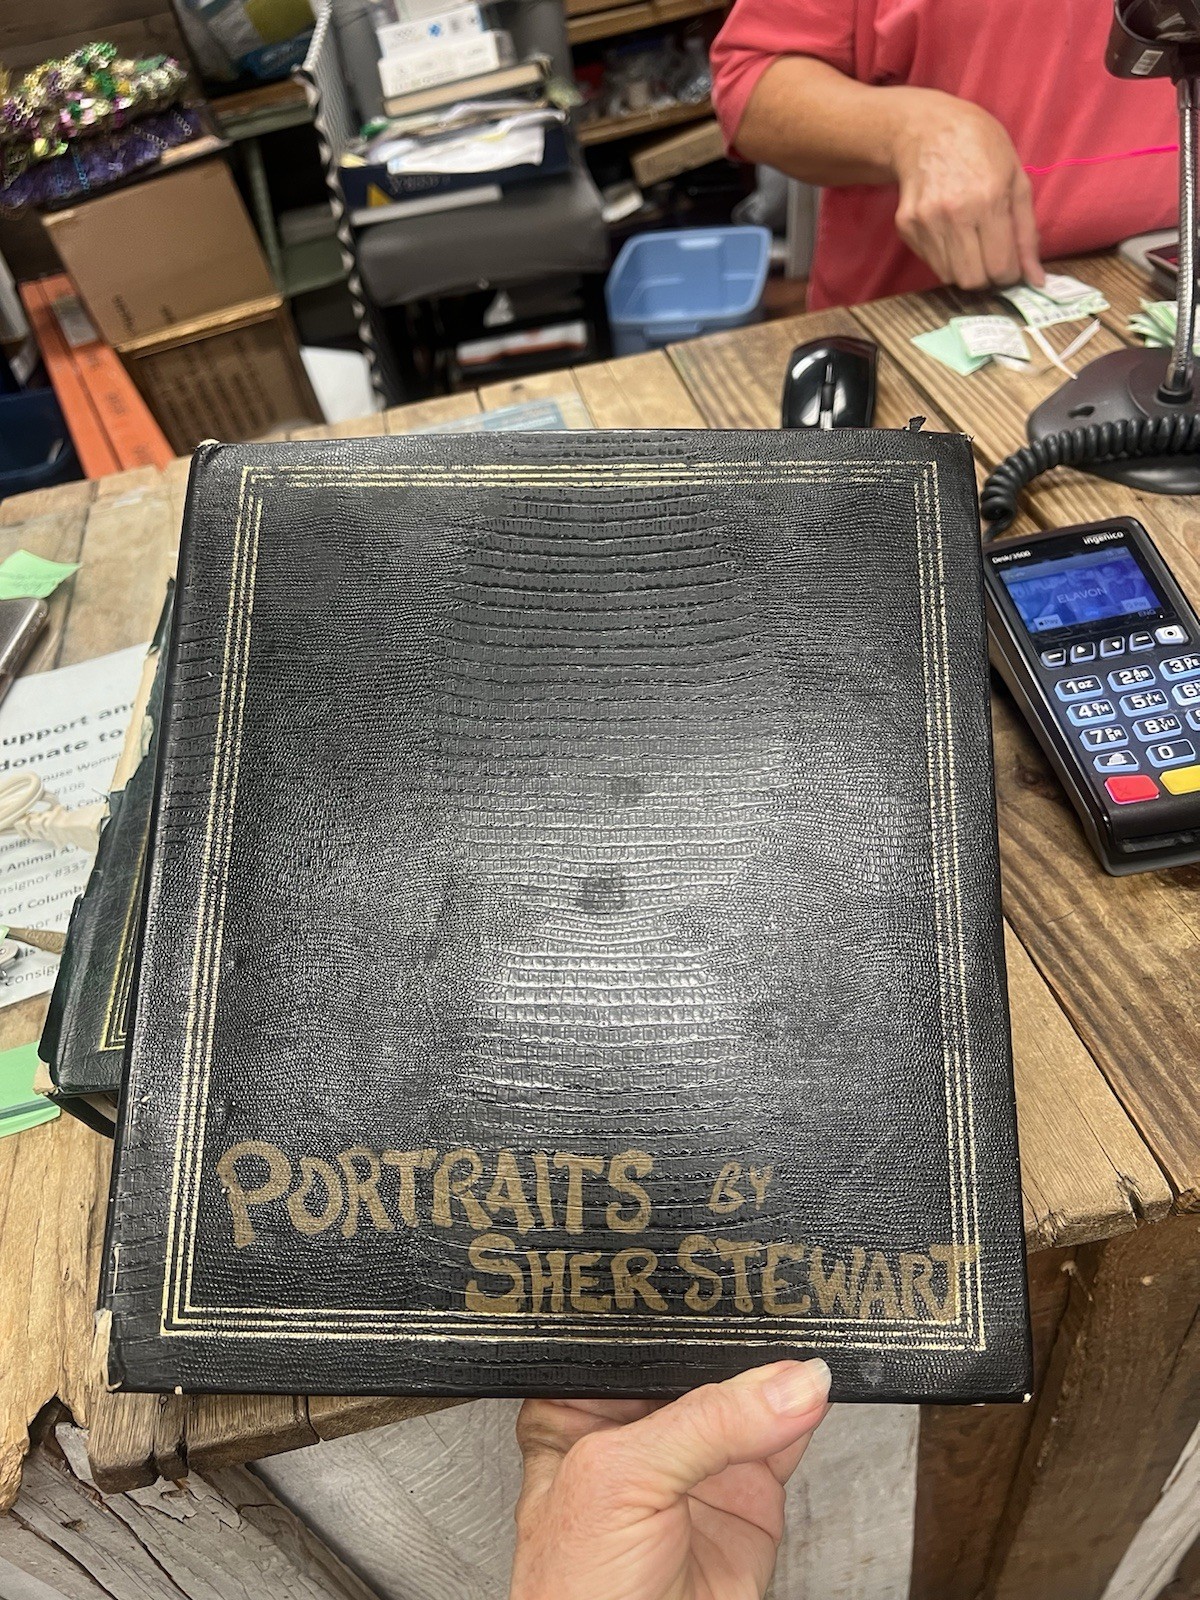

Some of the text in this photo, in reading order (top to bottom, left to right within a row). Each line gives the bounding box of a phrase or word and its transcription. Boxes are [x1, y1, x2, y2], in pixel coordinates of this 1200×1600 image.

[1082, 531, 1125, 545] ingenico
[1056, 586, 1107, 604] ELAVON
[1169, 660, 1184, 672] 3
[1119, 671, 1135, 684] 2
[1066, 681, 1079, 693] 1
[1182, 684, 1198, 697] 6
[1131, 694, 1148, 708] 5
[1079, 704, 1093, 718] 4
[1144, 720, 1160, 734] 8
[99, 728, 123, 742] to
[1090, 729, 1103, 743] 7
[1157, 745, 1174, 759] 0
[7, 848, 57, 873] Animal
[8, 904, 22, 915] of
[216, 1139, 775, 1249] PORTRAITS BY
[464, 1233, 982, 1323] SHER STEWART
